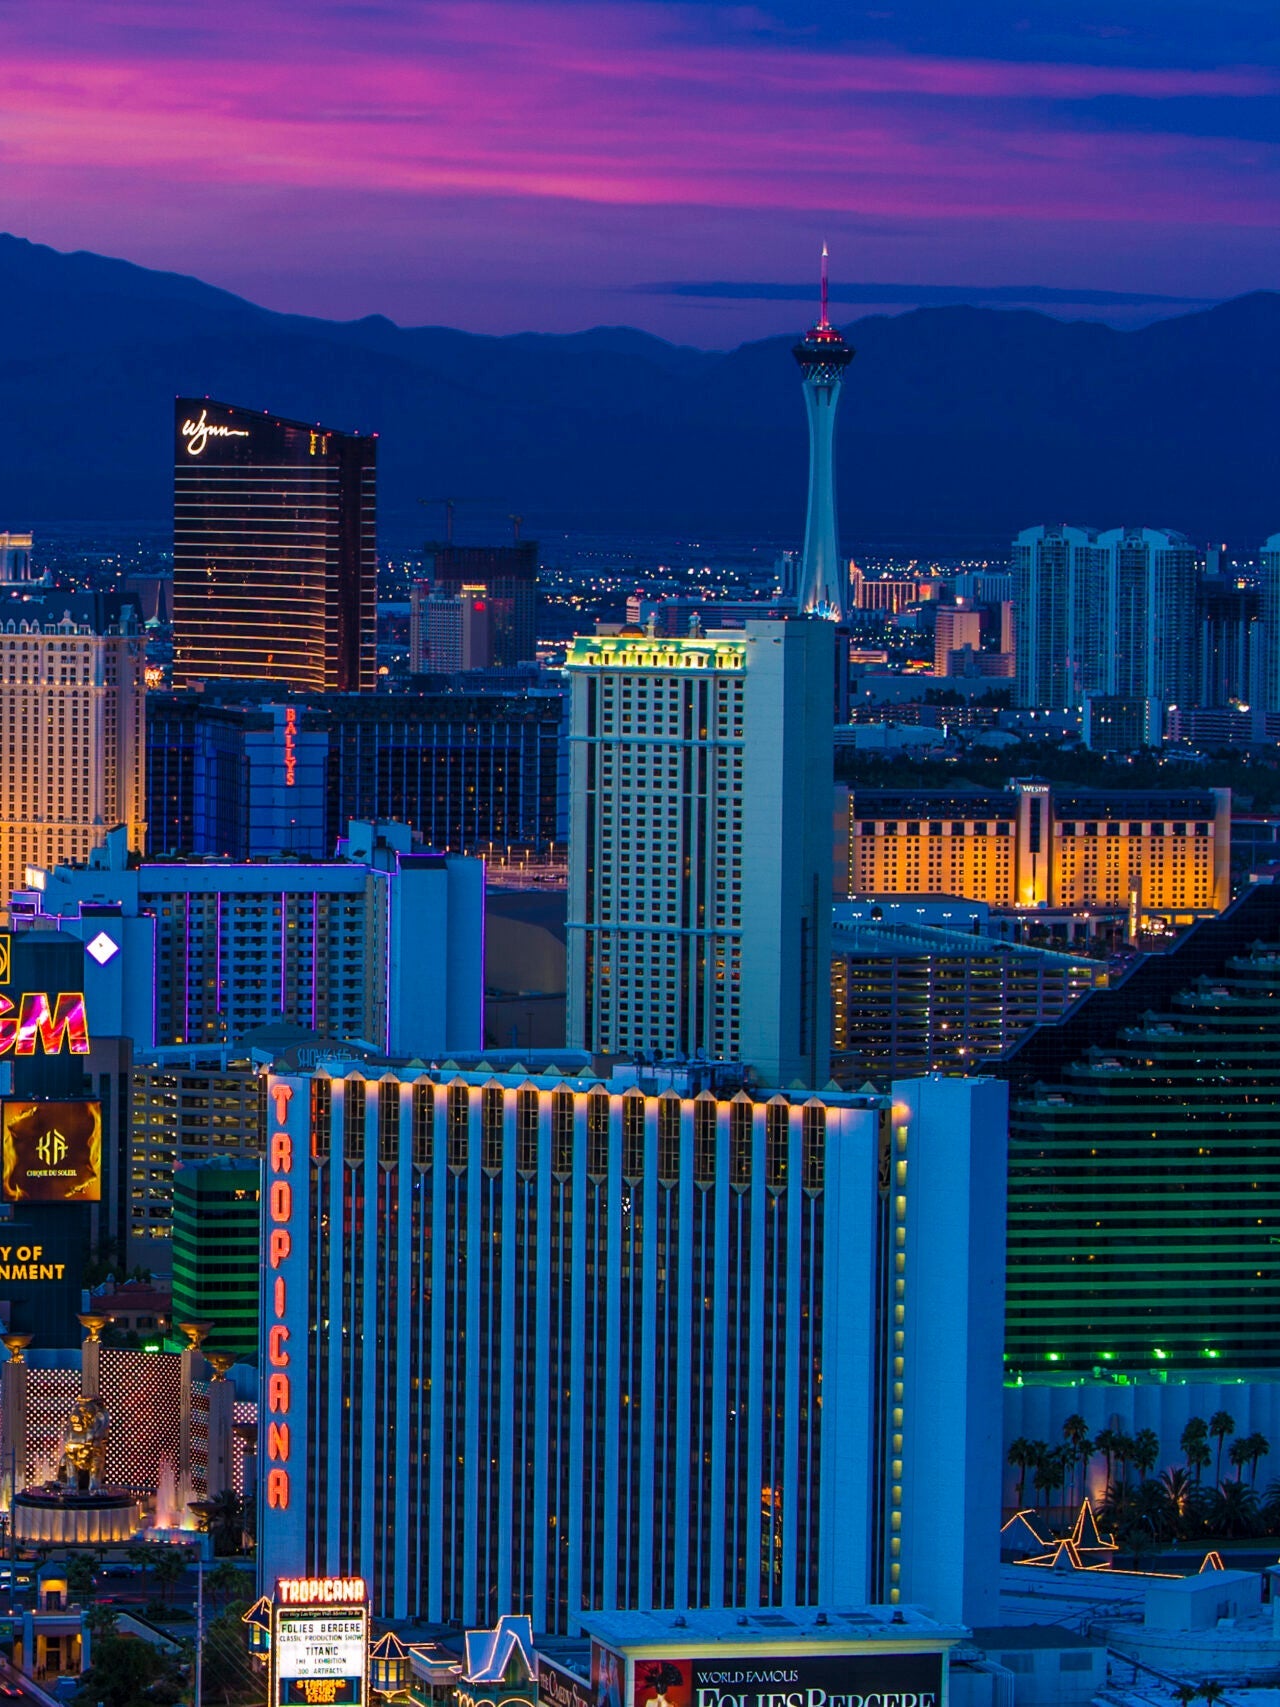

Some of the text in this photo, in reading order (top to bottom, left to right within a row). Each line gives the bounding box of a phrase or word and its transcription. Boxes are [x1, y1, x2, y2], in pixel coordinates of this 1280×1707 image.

[1022, 784, 1049, 793] WESTIN
[16, 1246, 42, 1262] OF
[267, 1084, 293, 1510] TROPICANA
[279, 1580, 365, 1602] TROPICANA
[281, 1623, 361, 1633] FOLIES BERGERE
[305, 1646, 339, 1656] TITANIC
[697, 1670, 799, 1684] WORLD FAMOUS
